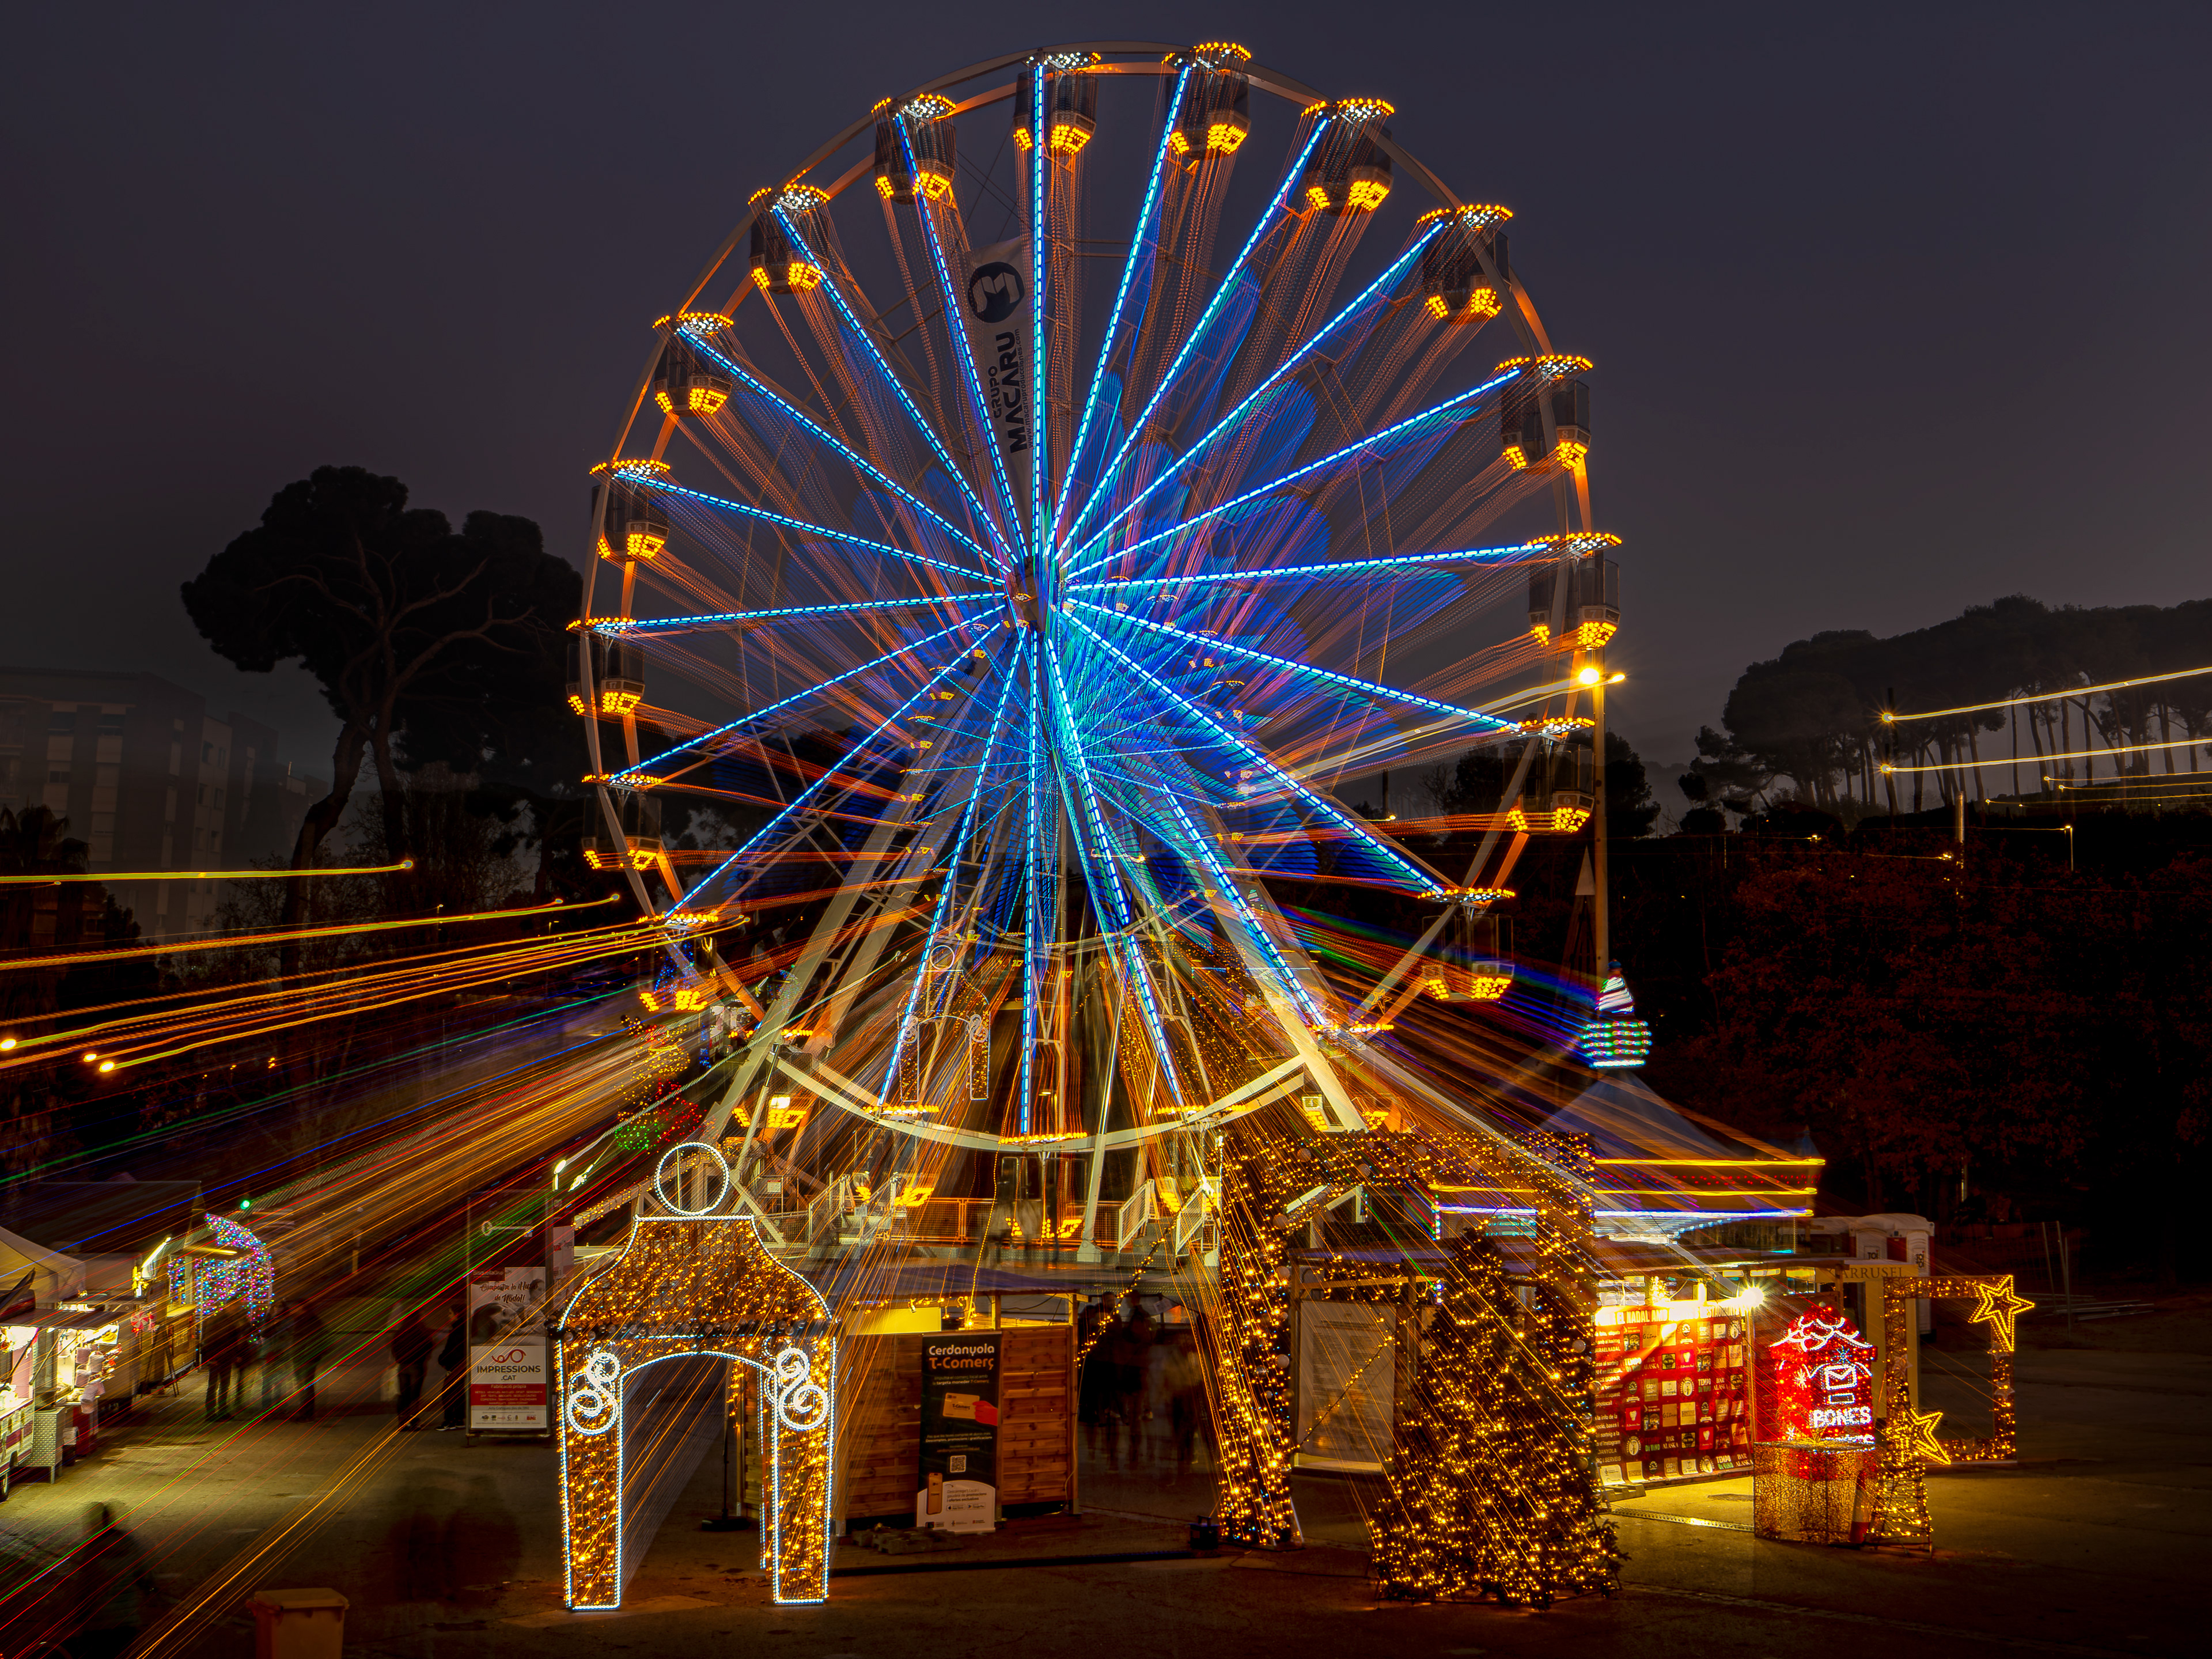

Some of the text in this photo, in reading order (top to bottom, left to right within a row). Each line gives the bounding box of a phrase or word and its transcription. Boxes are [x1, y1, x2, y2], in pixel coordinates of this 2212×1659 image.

[987, 365, 1002, 419] GRUPO
[996, 331, 1028, 454] MACARU
[1014, 328, 1033, 450] www.macaruproducciones.com
[1562, 430, 1569, 438] 8
[1590, 610, 1596, 618] 7
[1626, 1309, 1650, 1323] NADAL
[929, 1343, 995, 1356] Cerdanyola
[476, 1365, 541, 1373] IMPRESSIONS
[929, 1357, 994, 1370] T-Comerç
[1716, 1455, 1732, 1464] TEMPO
